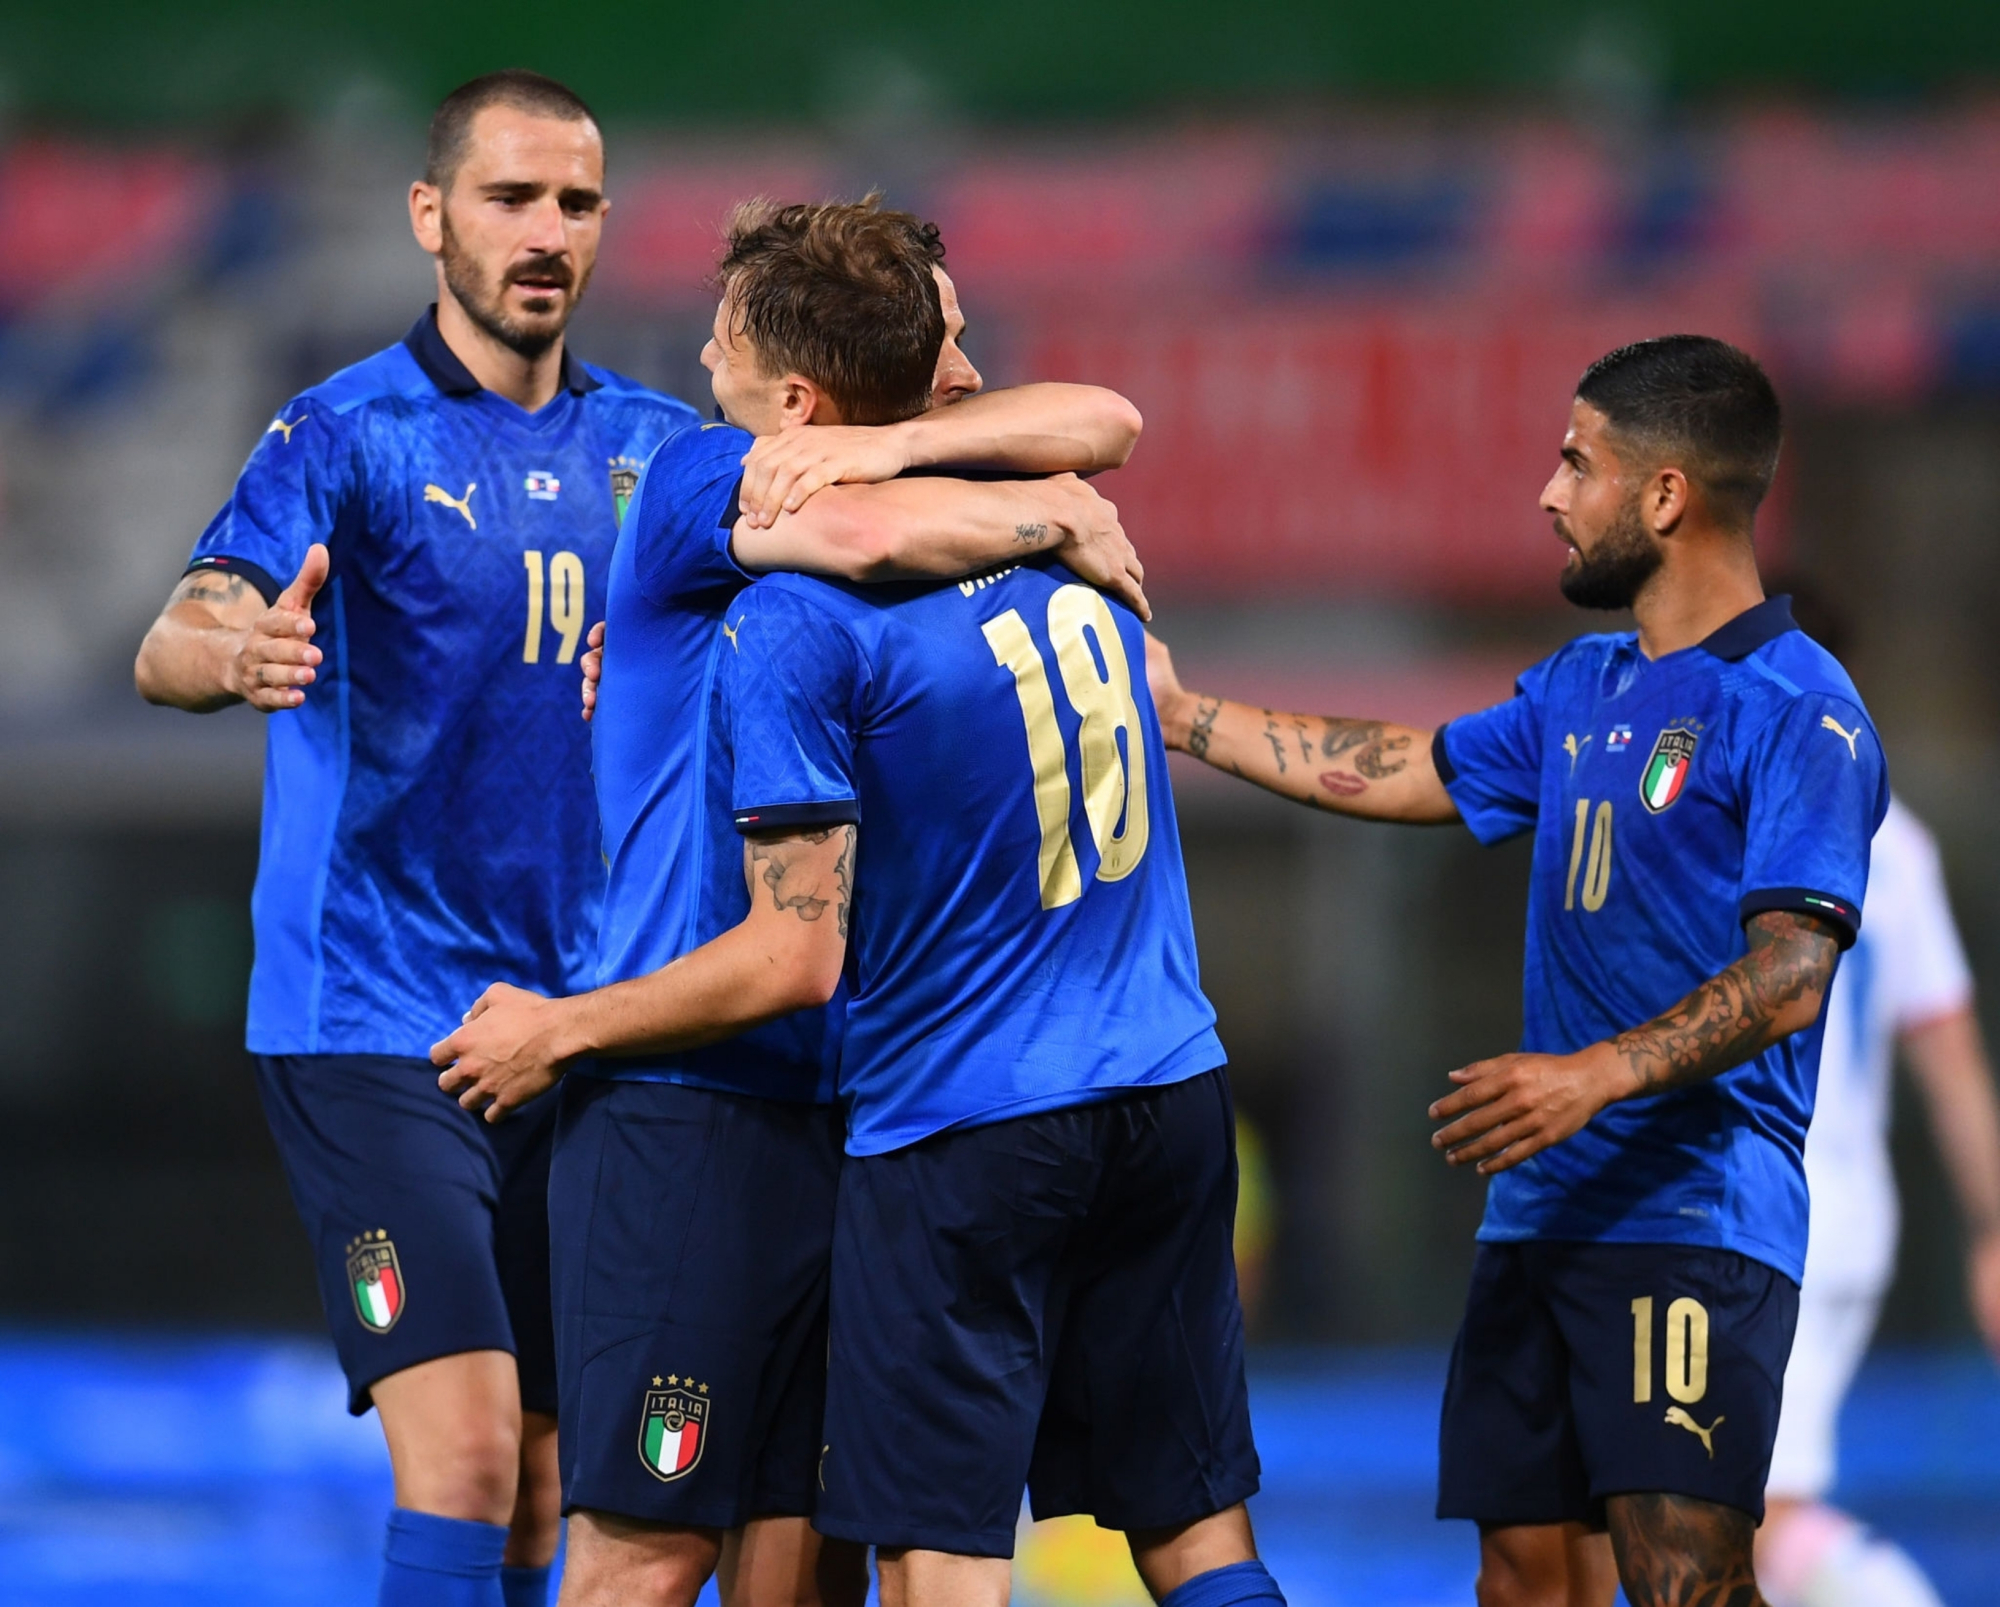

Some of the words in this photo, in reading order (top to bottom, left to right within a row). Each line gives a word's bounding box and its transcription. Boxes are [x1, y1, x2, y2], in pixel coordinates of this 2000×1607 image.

[523, 550, 584, 664] 19
[980, 583, 1149, 911] 18
[1660, 735, 1695, 752] ITALIA
[1564, 798, 1612, 912] 10
[1630, 1296, 1709, 1404] 10
[651, 1396, 703, 1416] ITALIA
